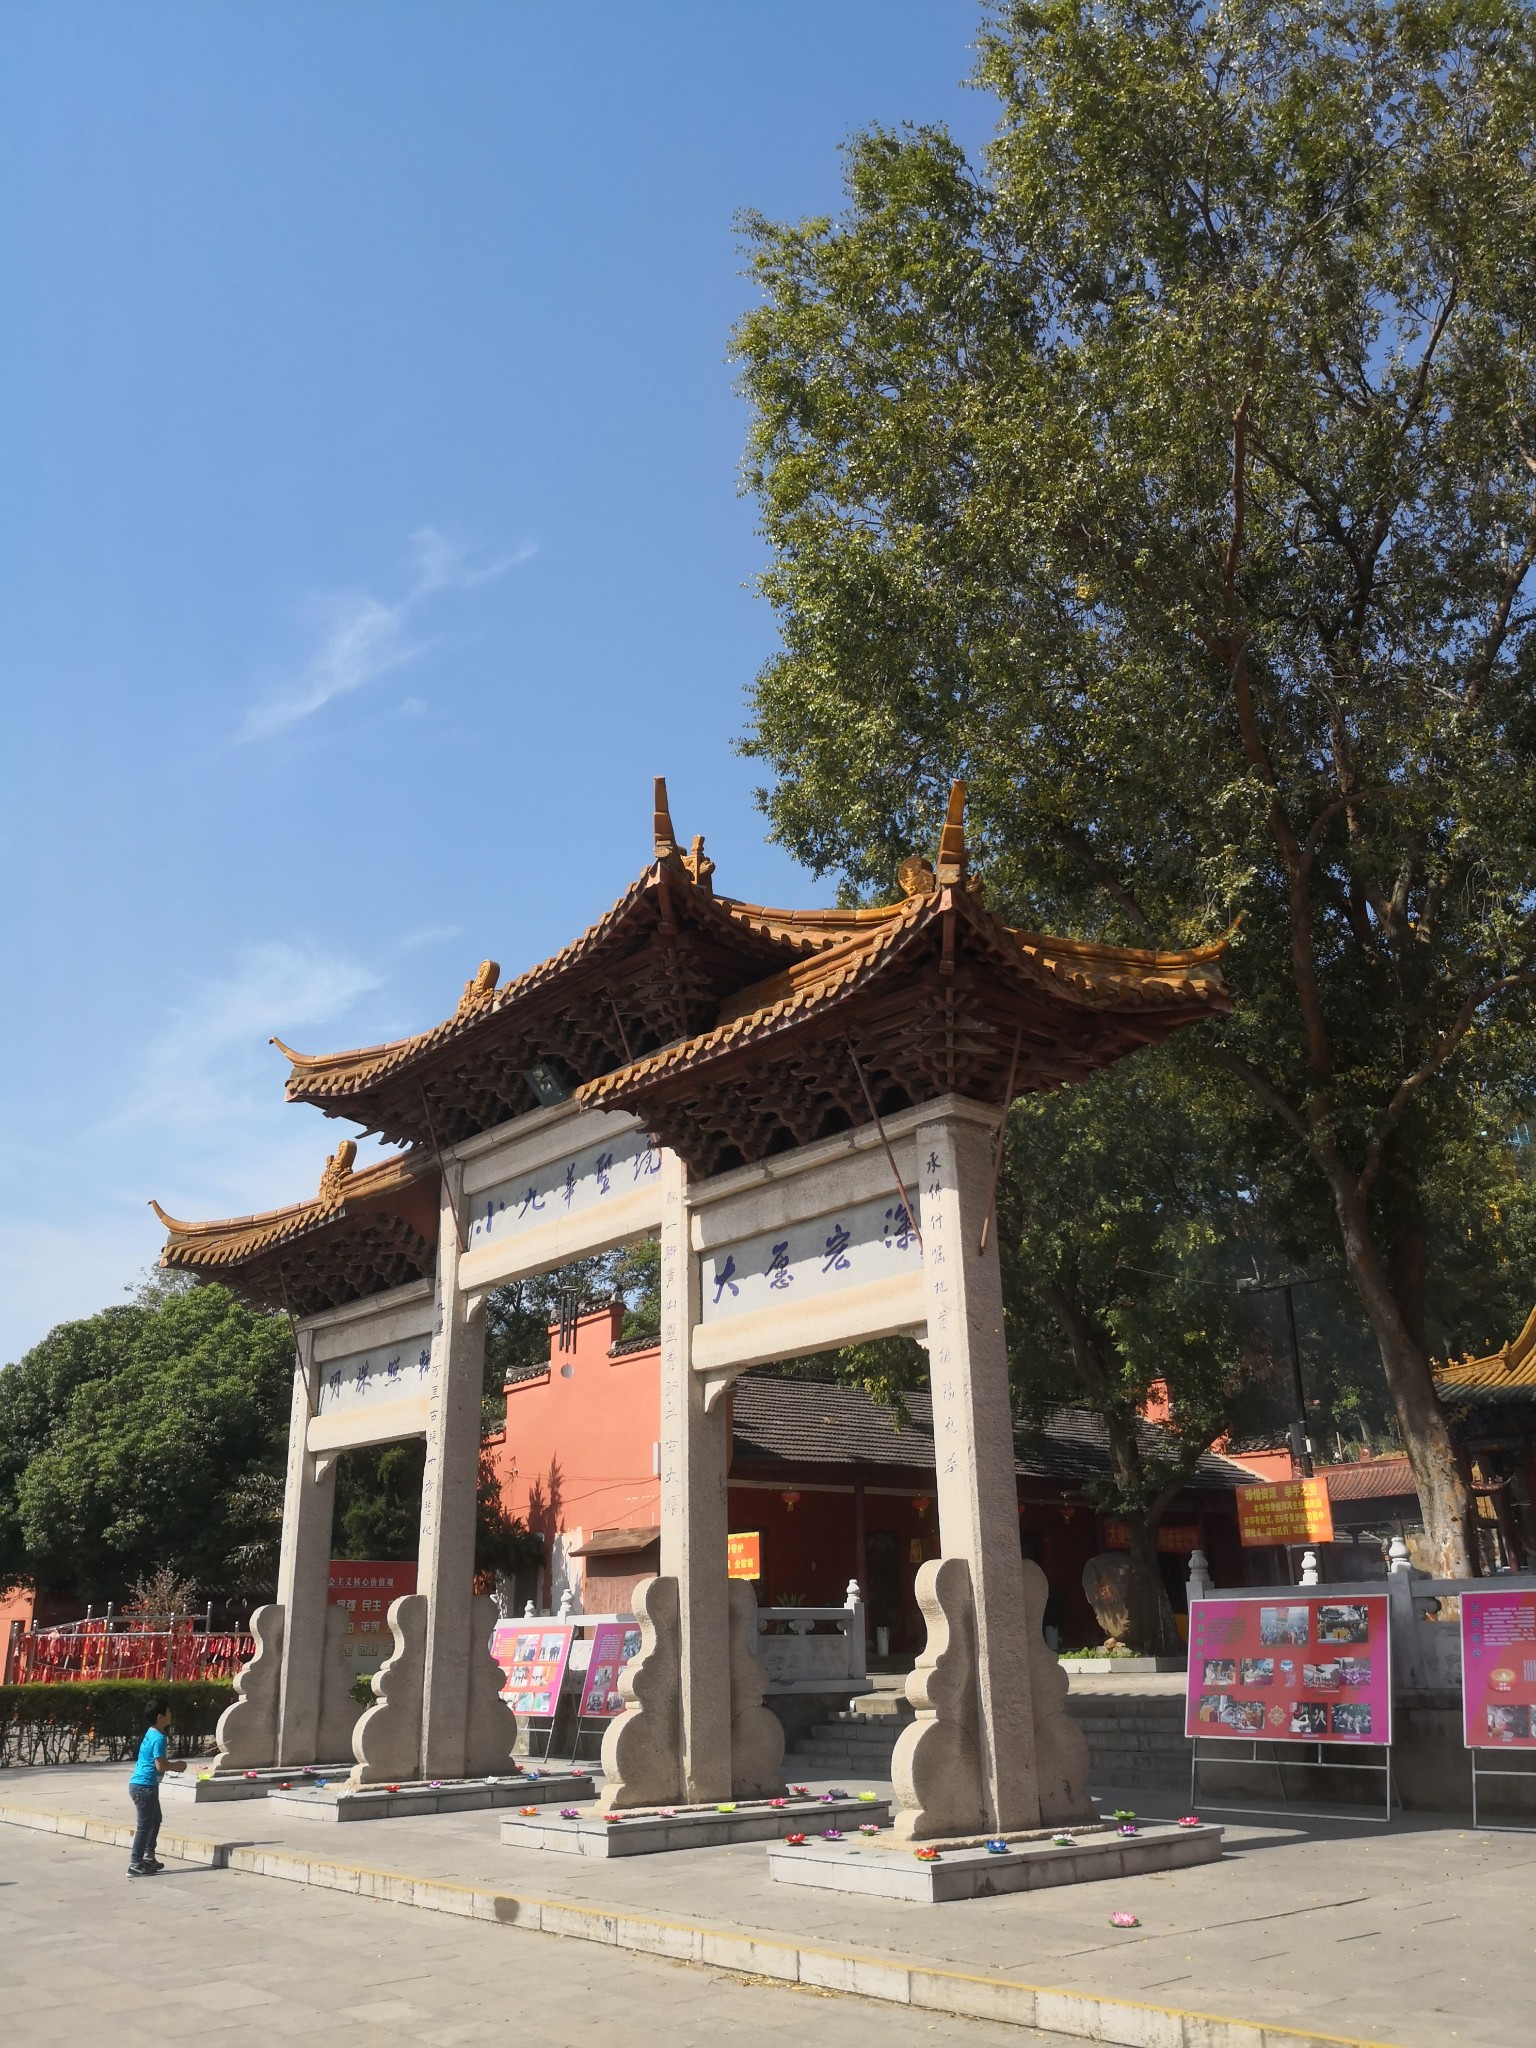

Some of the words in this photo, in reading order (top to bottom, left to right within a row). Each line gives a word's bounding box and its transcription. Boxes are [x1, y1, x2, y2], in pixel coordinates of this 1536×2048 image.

[1245, 1487, 1278, 1501] 珍惜资源
[1283, 1482, 1318, 1498] 举手之劳
[362, 1600, 381, 1612] 民主
[361, 1621, 381, 1634] 平等
